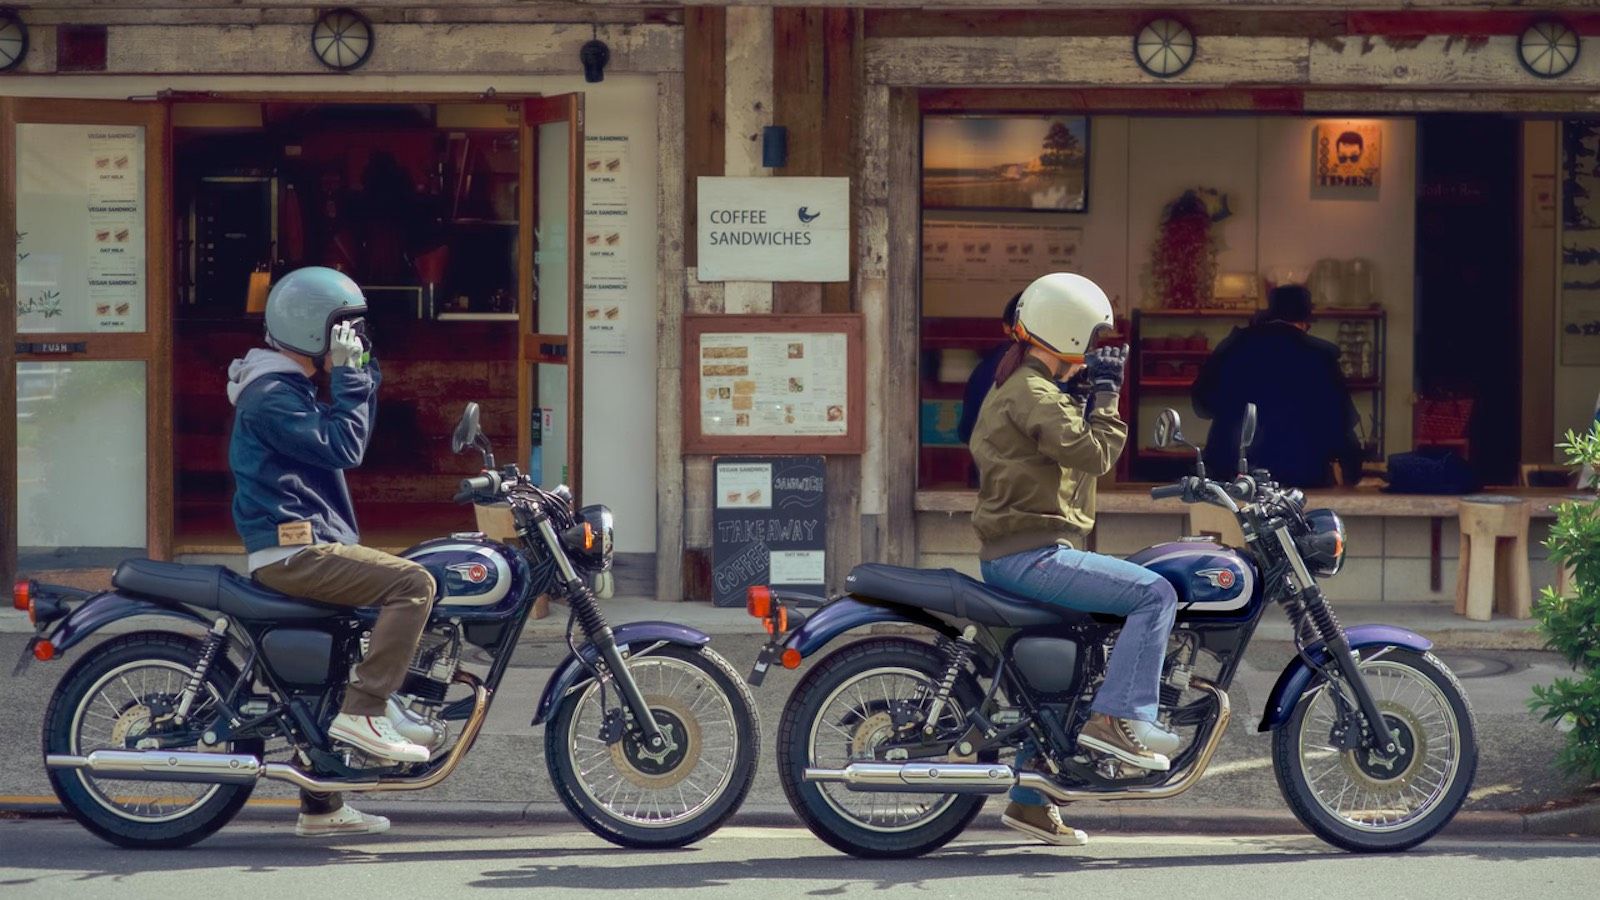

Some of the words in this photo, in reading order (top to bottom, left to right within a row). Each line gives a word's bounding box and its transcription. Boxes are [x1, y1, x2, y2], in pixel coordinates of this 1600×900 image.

[710, 210, 767, 224] COFFEE
[710, 231, 812, 245] SANDWICHES
[42, 343, 67, 352] PUSH
[718, 519, 818, 543] TAKEAWAY
[715, 543, 769, 595] COFFEE
